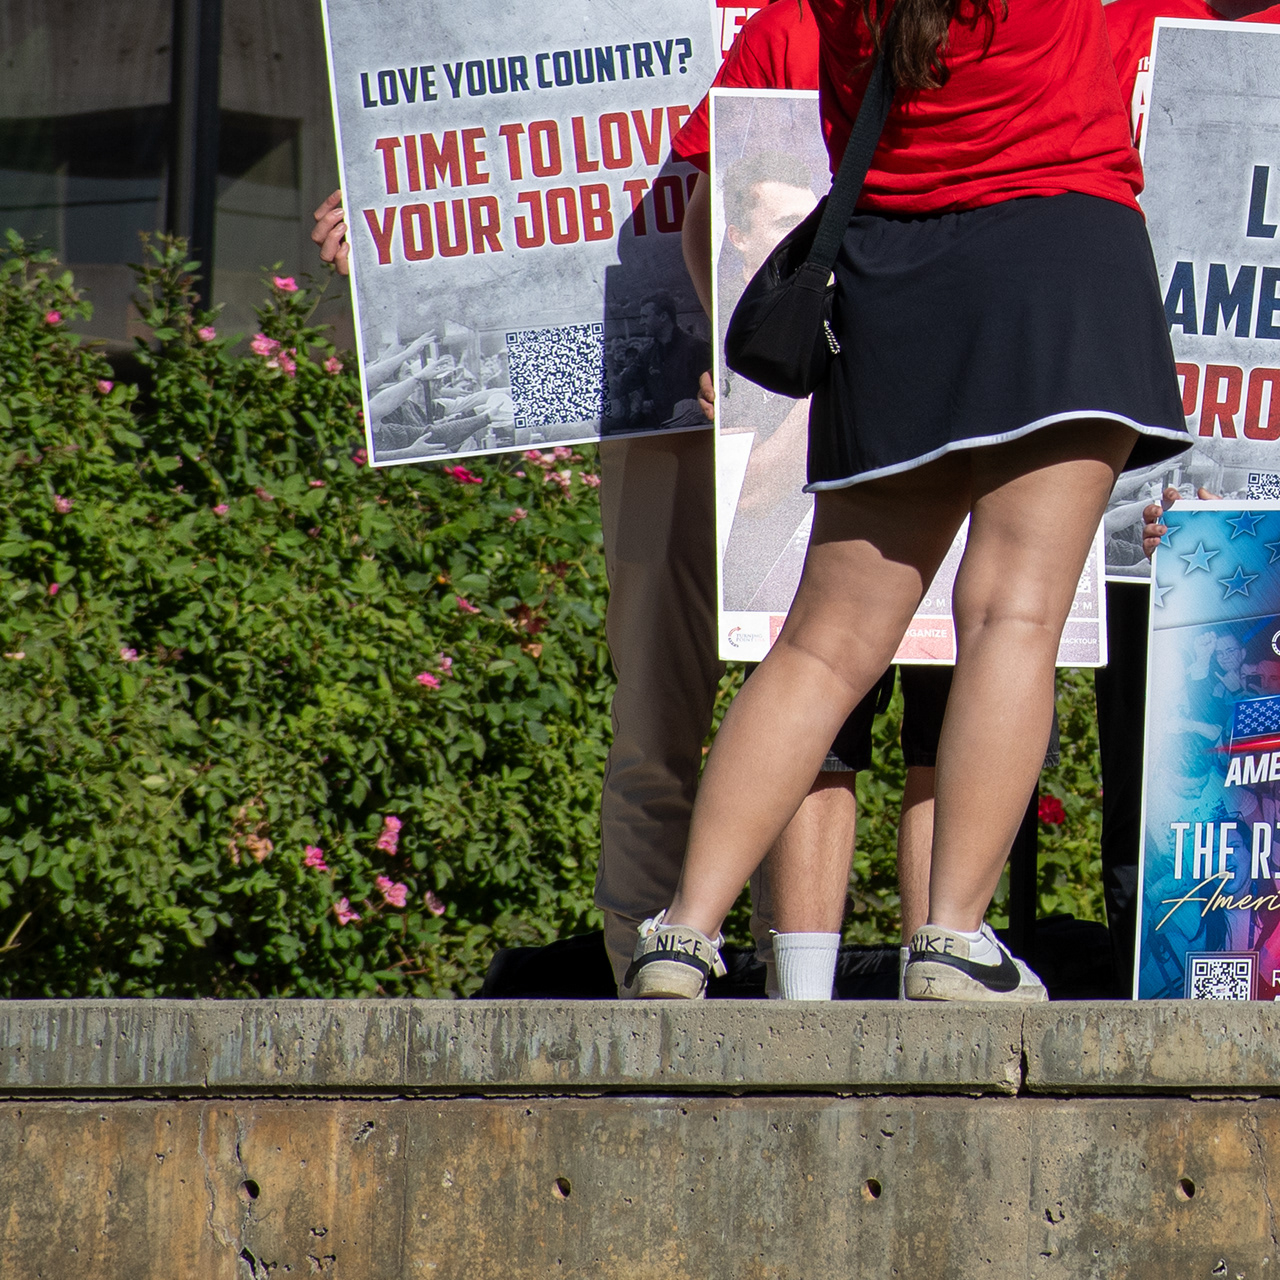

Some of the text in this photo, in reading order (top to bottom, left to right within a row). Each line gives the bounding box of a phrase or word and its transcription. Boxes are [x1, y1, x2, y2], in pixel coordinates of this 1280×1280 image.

[360, 37, 693, 109] LOVE YOUR COUNTRY?
[375, 127, 490, 195] TIME
[499, 119, 563, 181] TO
[363, 195, 504, 266] YOUR
[514, 182, 615, 249] JOB
[1170, 821, 1238, 879] THE
[656, 934, 703, 957] NIKE
